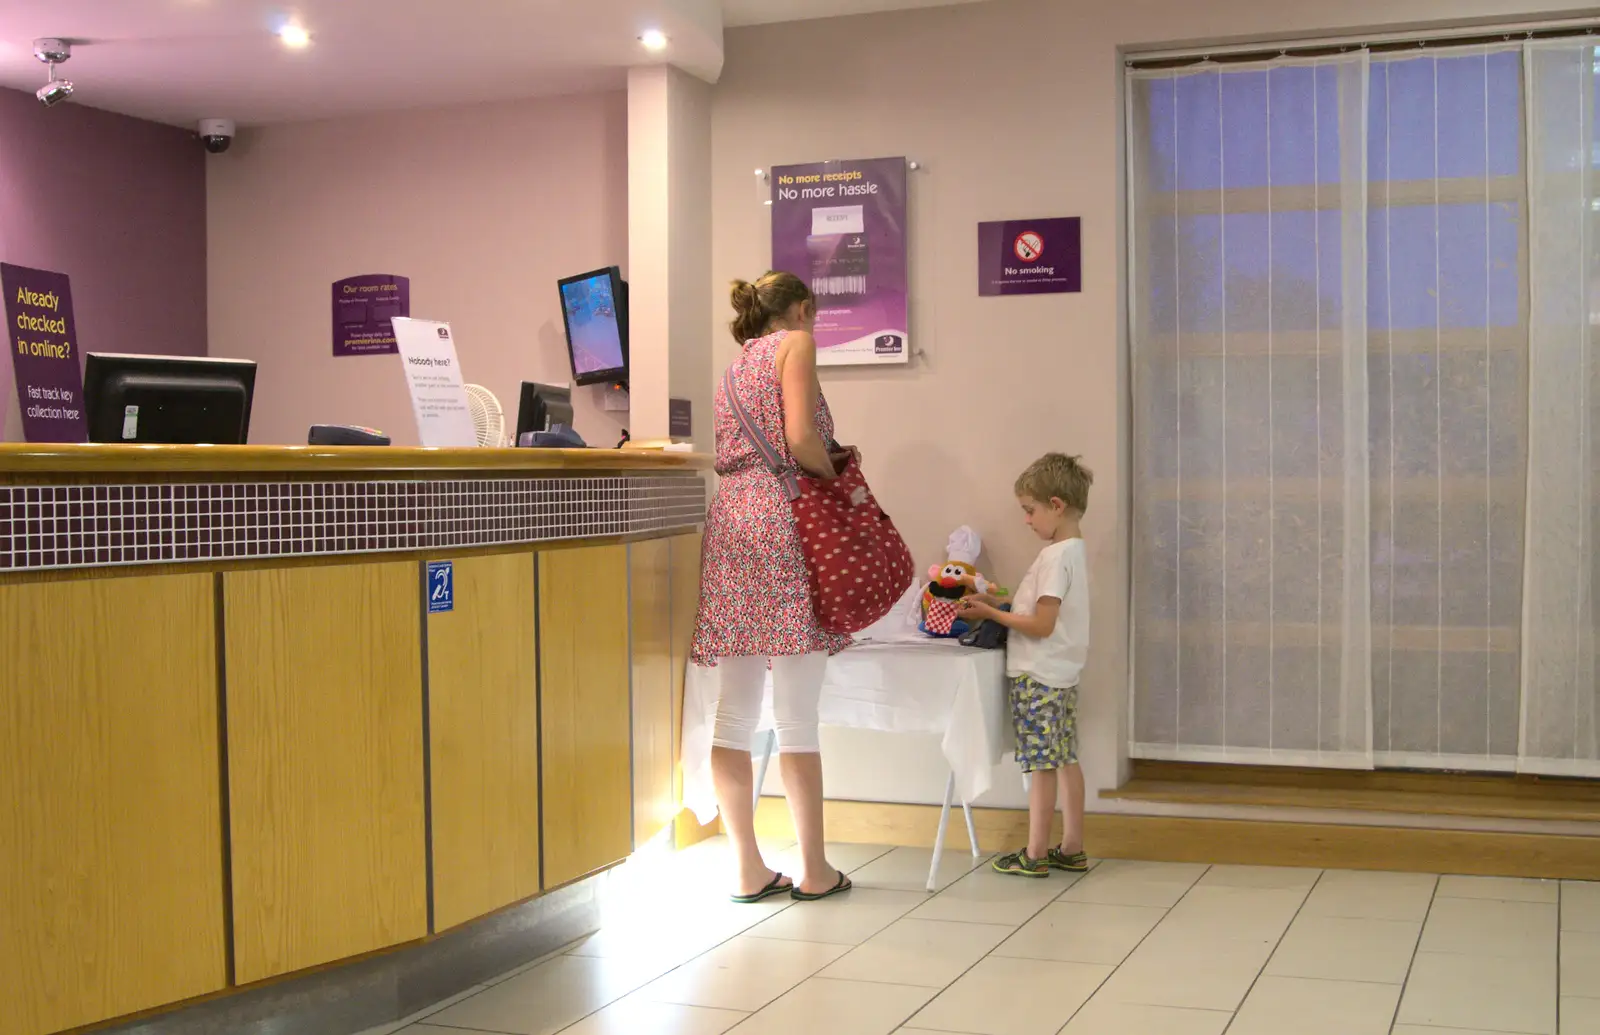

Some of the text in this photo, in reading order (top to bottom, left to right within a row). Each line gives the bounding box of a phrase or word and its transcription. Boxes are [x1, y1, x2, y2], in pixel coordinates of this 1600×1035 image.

[778, 170, 862, 185] No more receipts
[779, 181, 878, 200] No more hassle
[1004, 265, 1054, 275] No smoking
[343, 285, 357, 293] Our
[17, 286, 59, 312] Already
[17, 312, 66, 334] checked
[17, 336, 71, 359] in online?
[408, 356, 450, 367] Nobody here?
[27, 385, 73, 403] Fast track key
[27, 404, 80, 420] collection here
